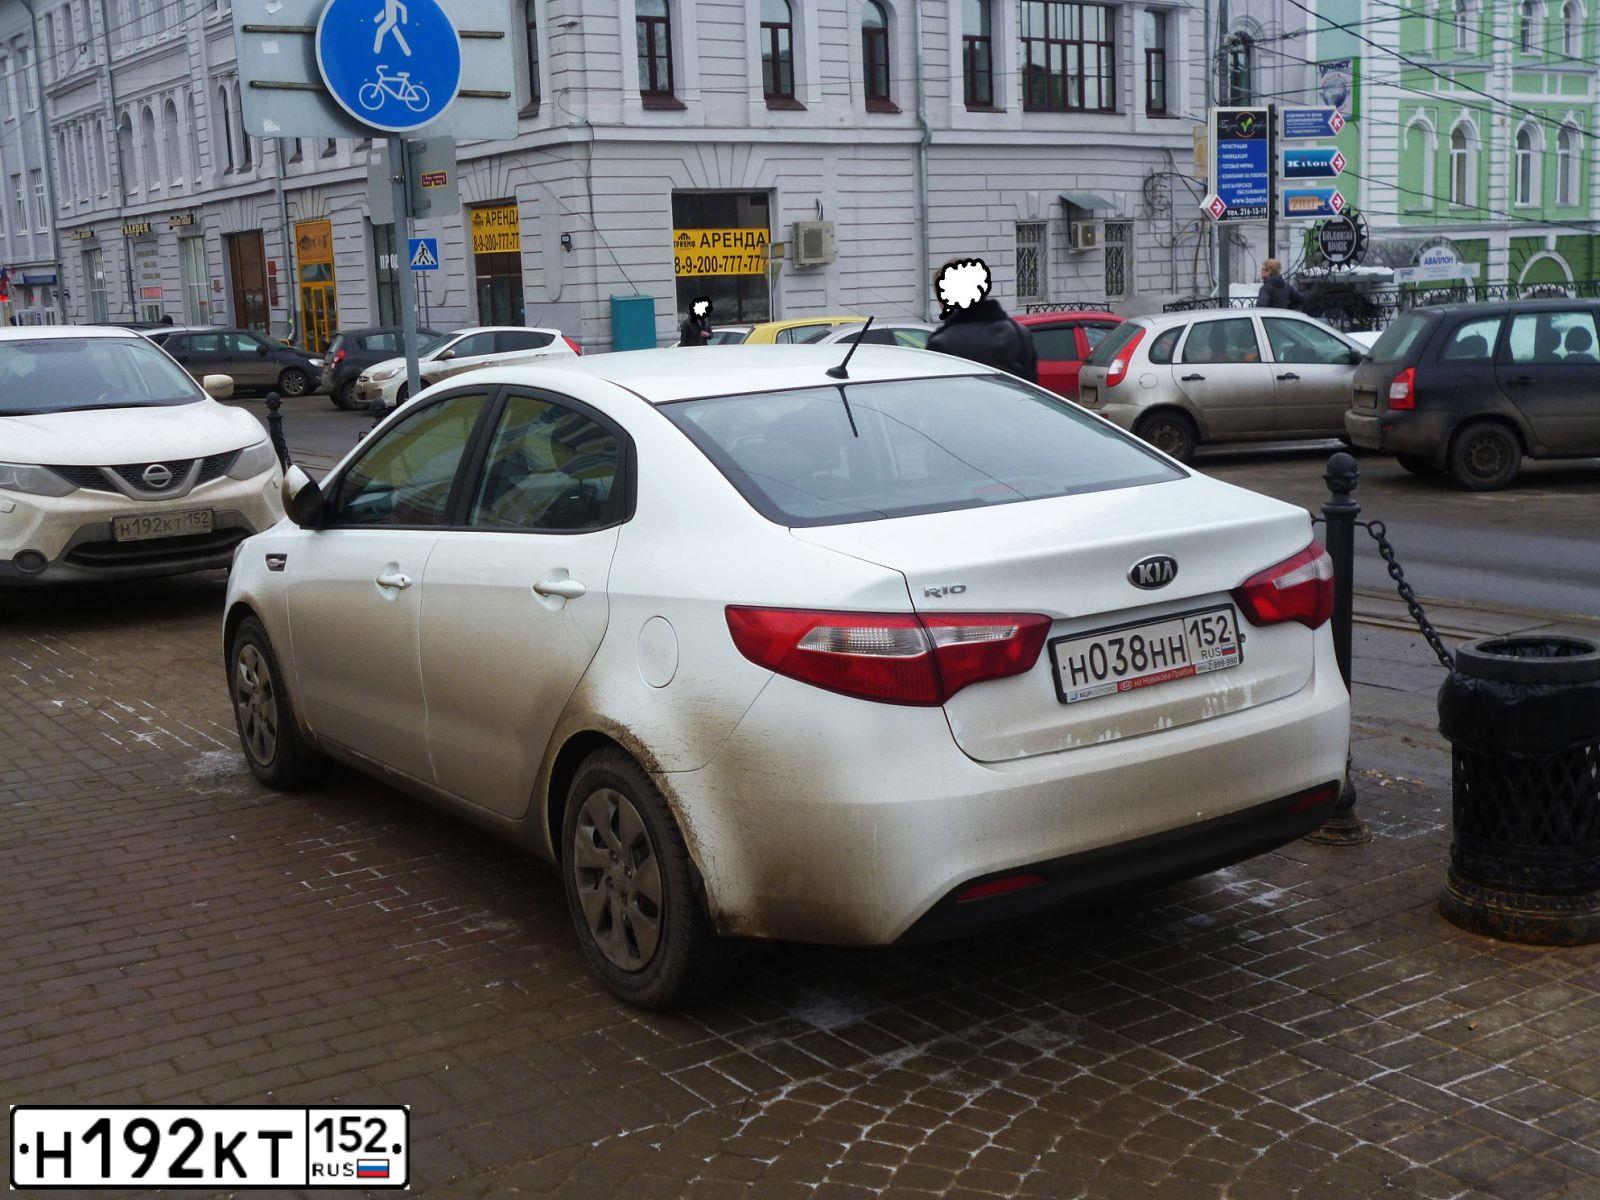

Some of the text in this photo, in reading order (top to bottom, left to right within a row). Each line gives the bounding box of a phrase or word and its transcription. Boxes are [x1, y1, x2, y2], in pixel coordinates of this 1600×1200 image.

[1286, 160, 1328, 168] Kiton
[700, 231, 766, 250] АРЕНДА
[120, 517, 183, 537] Н192КТ
[186, 511, 209, 526] 152
[1139, 560, 1176, 584] KIA
[924, 584, 968, 599] RIO
[1188, 615, 1231, 649] 152
[1068, 633, 1187, 687] Н038НН
[1201, 647, 1223, 661] RUS
